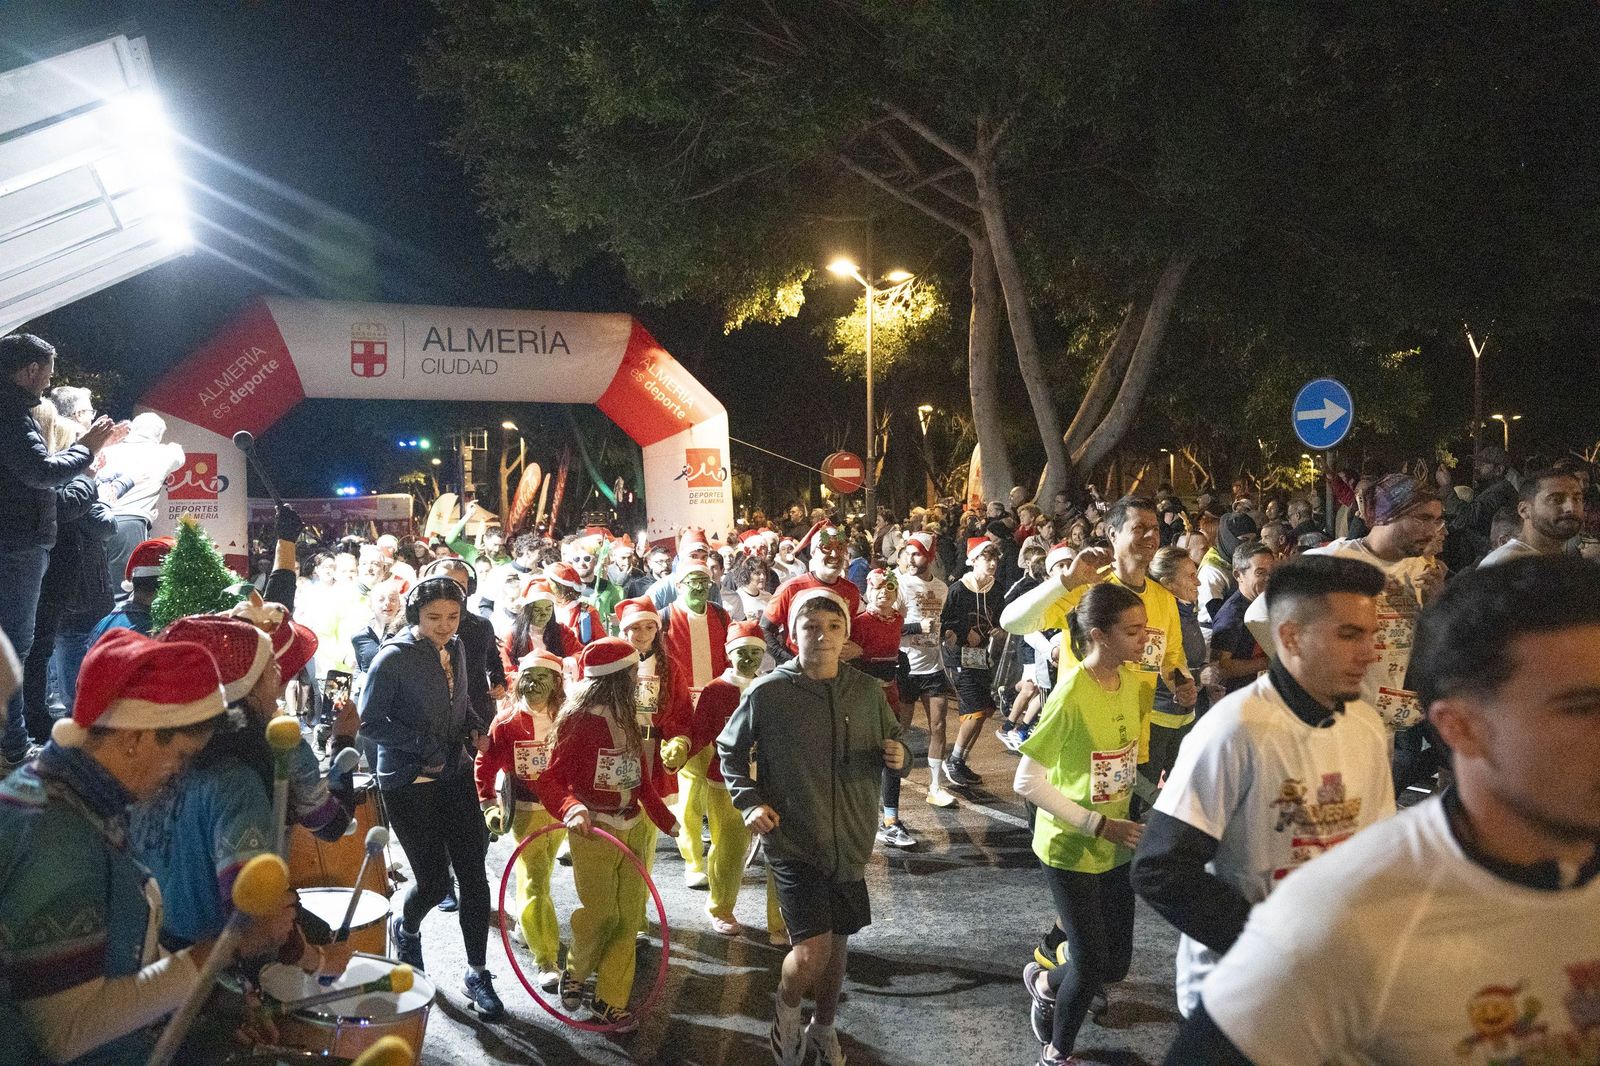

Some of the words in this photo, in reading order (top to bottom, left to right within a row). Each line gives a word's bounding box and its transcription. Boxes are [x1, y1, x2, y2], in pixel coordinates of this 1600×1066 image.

[422, 325, 570, 355] ALMERÍA
[198, 346, 267, 407] ALMERÍA
[421, 358, 499, 375] CIUDAD
[212, 401, 231, 419] es
[229, 359, 280, 404] deporte
[630, 368, 645, 383] es
[644, 380, 686, 420] deporte
[168, 505, 219, 513] DEPORTES
